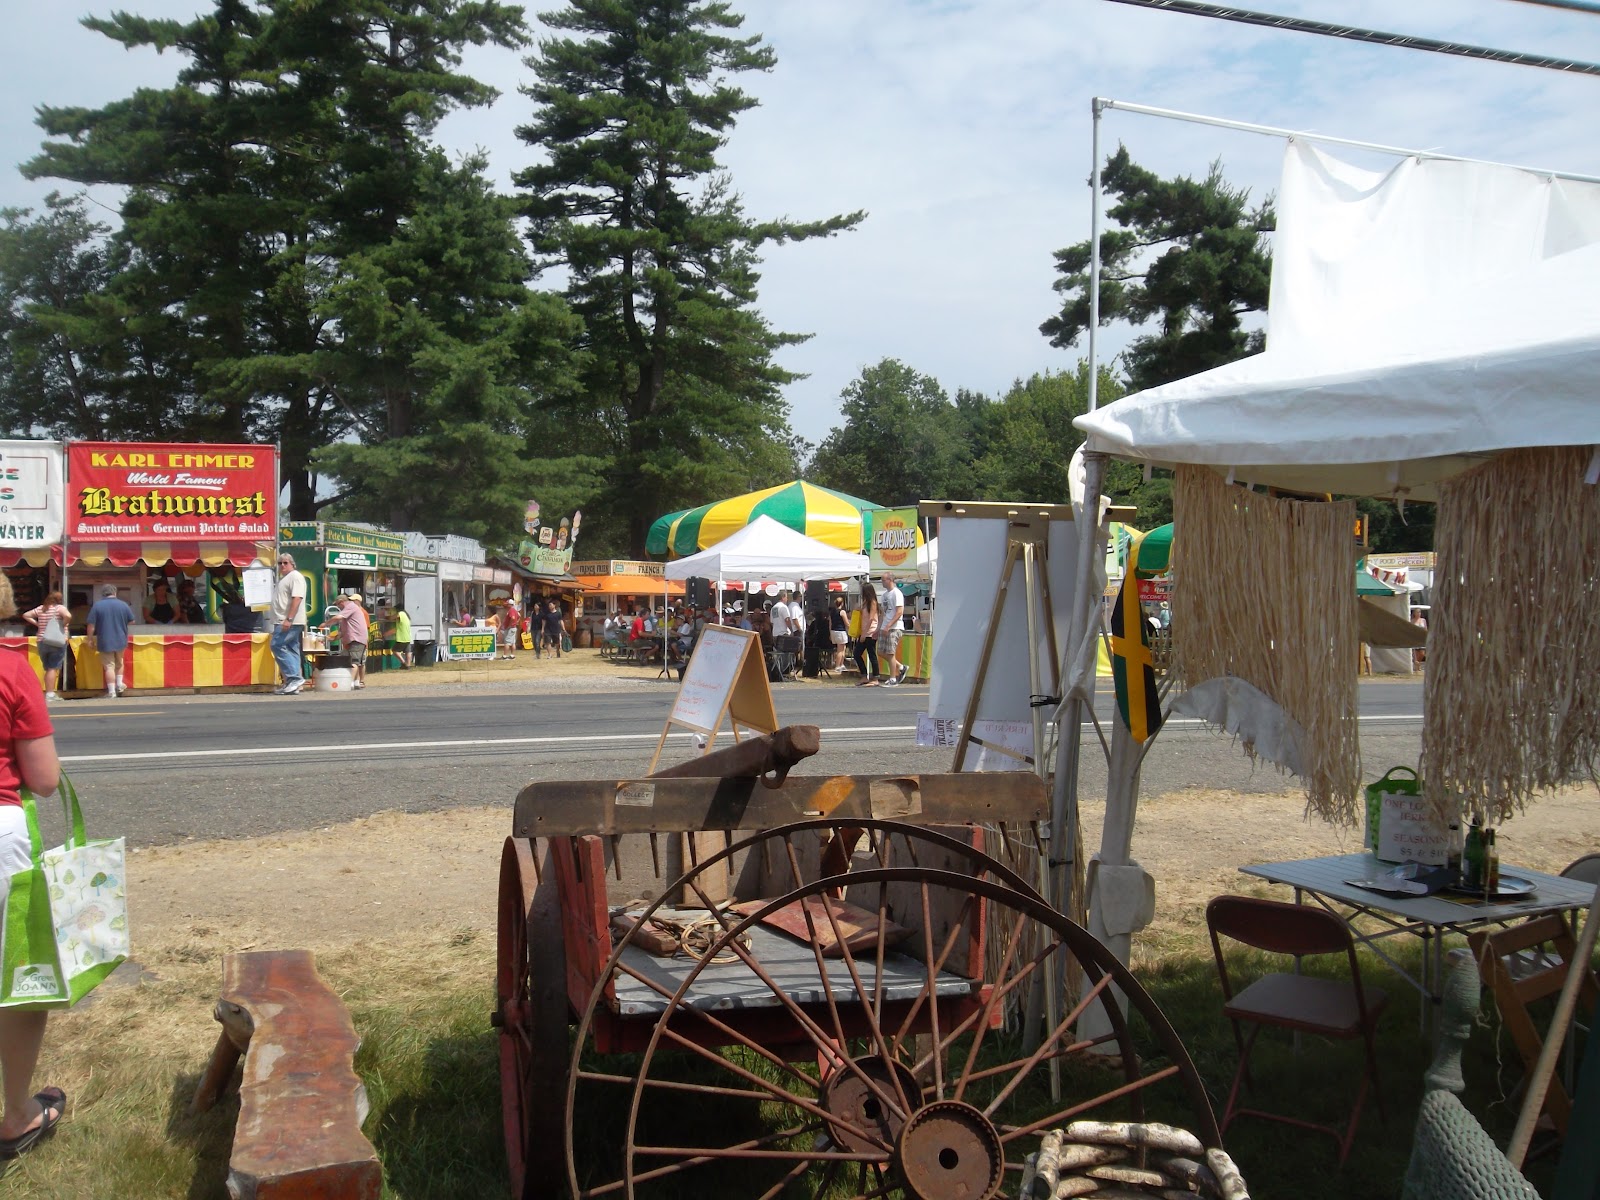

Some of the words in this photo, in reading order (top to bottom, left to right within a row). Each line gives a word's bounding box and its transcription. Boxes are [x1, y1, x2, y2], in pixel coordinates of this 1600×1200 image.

[91, 453, 161, 467] KARL
[127, 472, 170, 484] World
[174, 473, 228, 485] Famous
[79, 487, 267, 517] Bratwurst
[77, 522, 140, 534] Sauerkraut
[153, 522, 196, 533] German
[199, 522, 235, 535] Potato
[238, 522, 269, 533] Salad
[873, 528, 915, 550] LEMONADE
[334, 558, 371, 566] COFFEE
[339, 552, 366, 560] SODA
[638, 565, 660, 574] FRENCH
[1372, 567, 1407, 585] ATM
[451, 635, 494, 645] BEER
[456, 644, 491, 653] TENT
